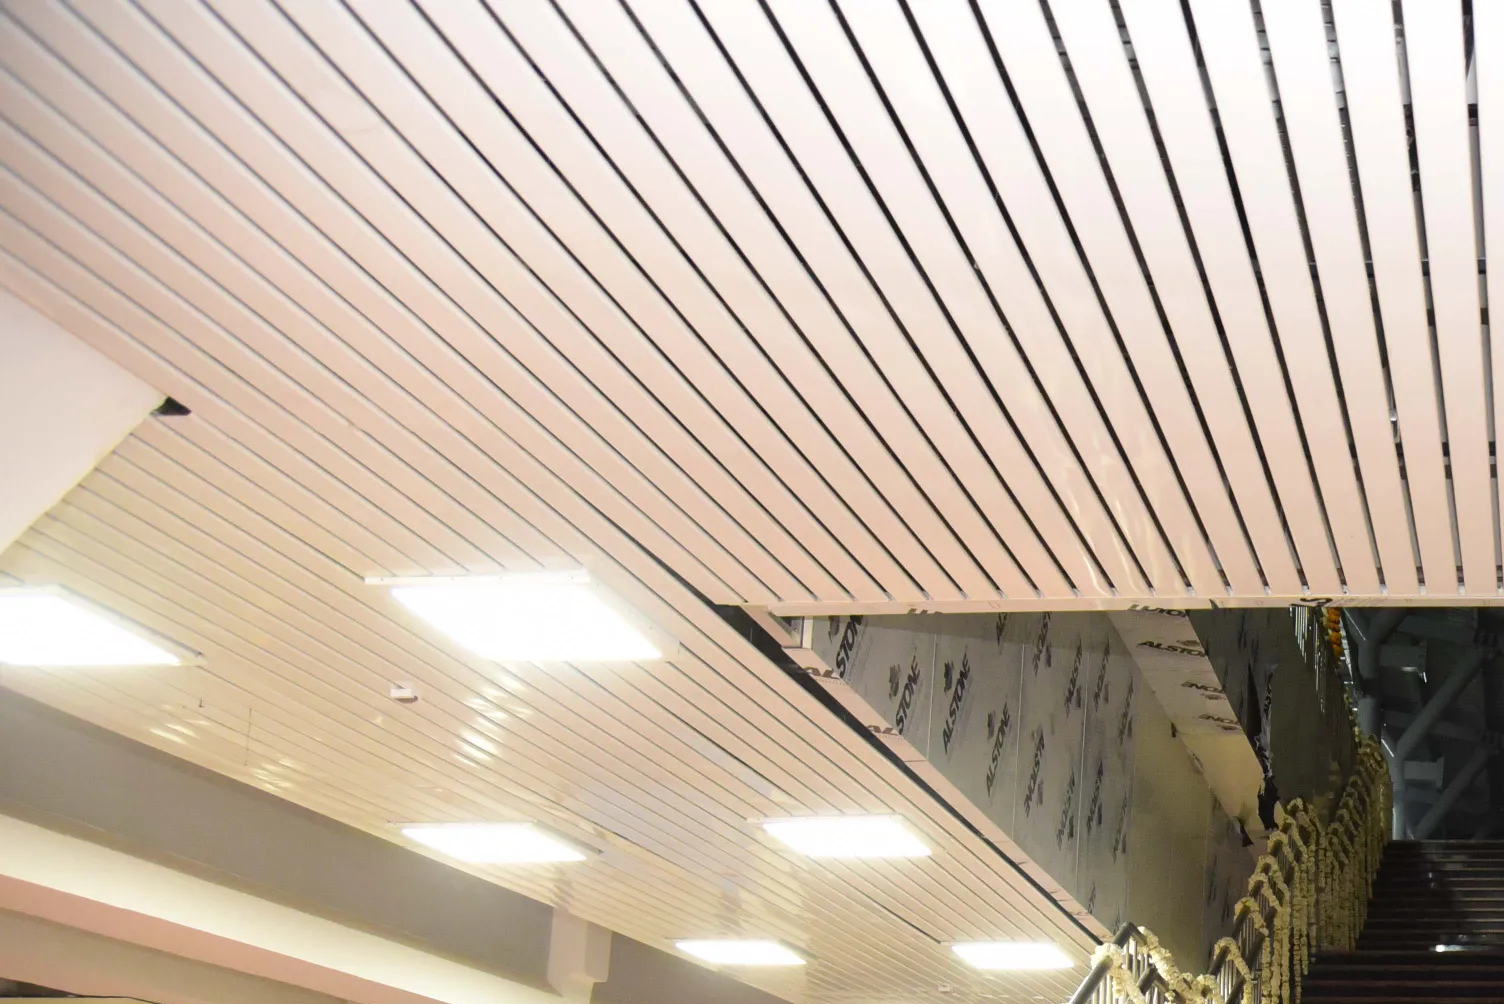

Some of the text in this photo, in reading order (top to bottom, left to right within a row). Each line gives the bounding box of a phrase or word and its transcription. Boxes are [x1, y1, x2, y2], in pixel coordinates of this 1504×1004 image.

[1136, 640, 1207, 658] ALSTO
[943, 651, 971, 755] ALSTONE
[986, 701, 1010, 797] ALSTONE
